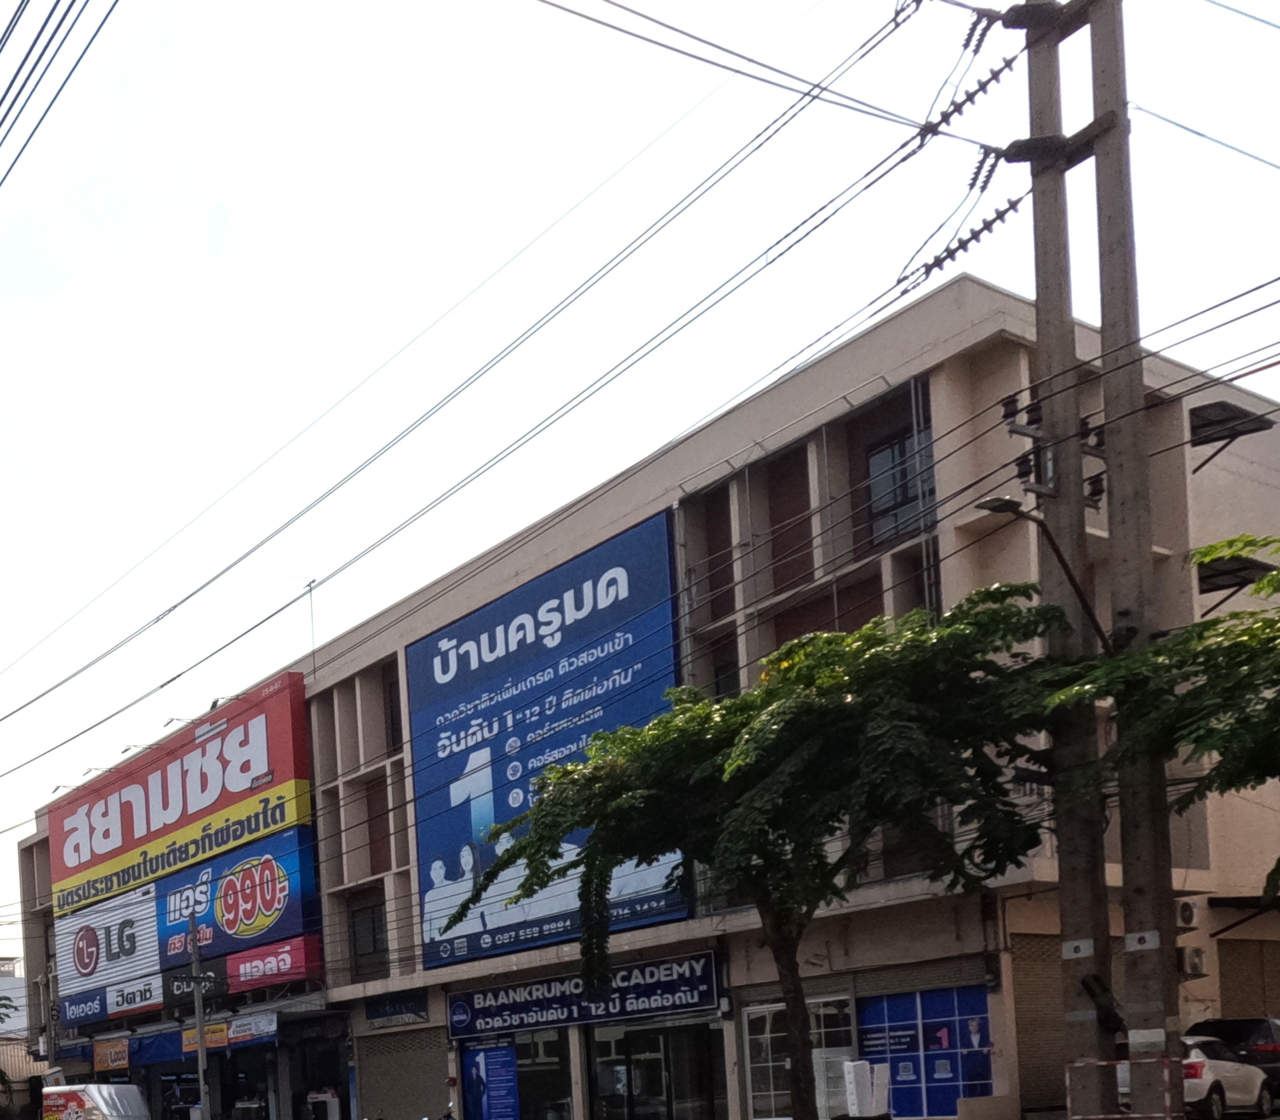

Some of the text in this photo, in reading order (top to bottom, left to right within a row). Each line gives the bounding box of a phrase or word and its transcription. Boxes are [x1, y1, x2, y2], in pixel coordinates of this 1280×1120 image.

[433, 566, 629, 684] บ้านครูมด
[559, 632, 634, 676] ติวสอบเข้า
[437, 716, 500, 759] อันดับ
[503, 710, 514, 732] 1
[545, 695, 557, 715] ปี
[62, 713, 270, 868] สยามชัย
[450, 747, 495, 843] 1
[56, 795, 287, 910] บัตรประชาชนใบเดียวก็ผ่อนได้
[167, 867, 213, 926] แอร์
[104, 919, 137, 962] LG
[168, 932, 186, 955] ทีวี
[239, 946, 292, 982] แอลจี
[65, 996, 101, 1020] ไฮเออร์
[473, 978, 588, 1009] BAANKRUMO
[475, 1003, 568, 1030] กวดวิชาอันดับ
[570, 1005, 579, 1018] 1
[609, 993, 620, 1014] ปี
[936, 1027, 949, 1049] 1
